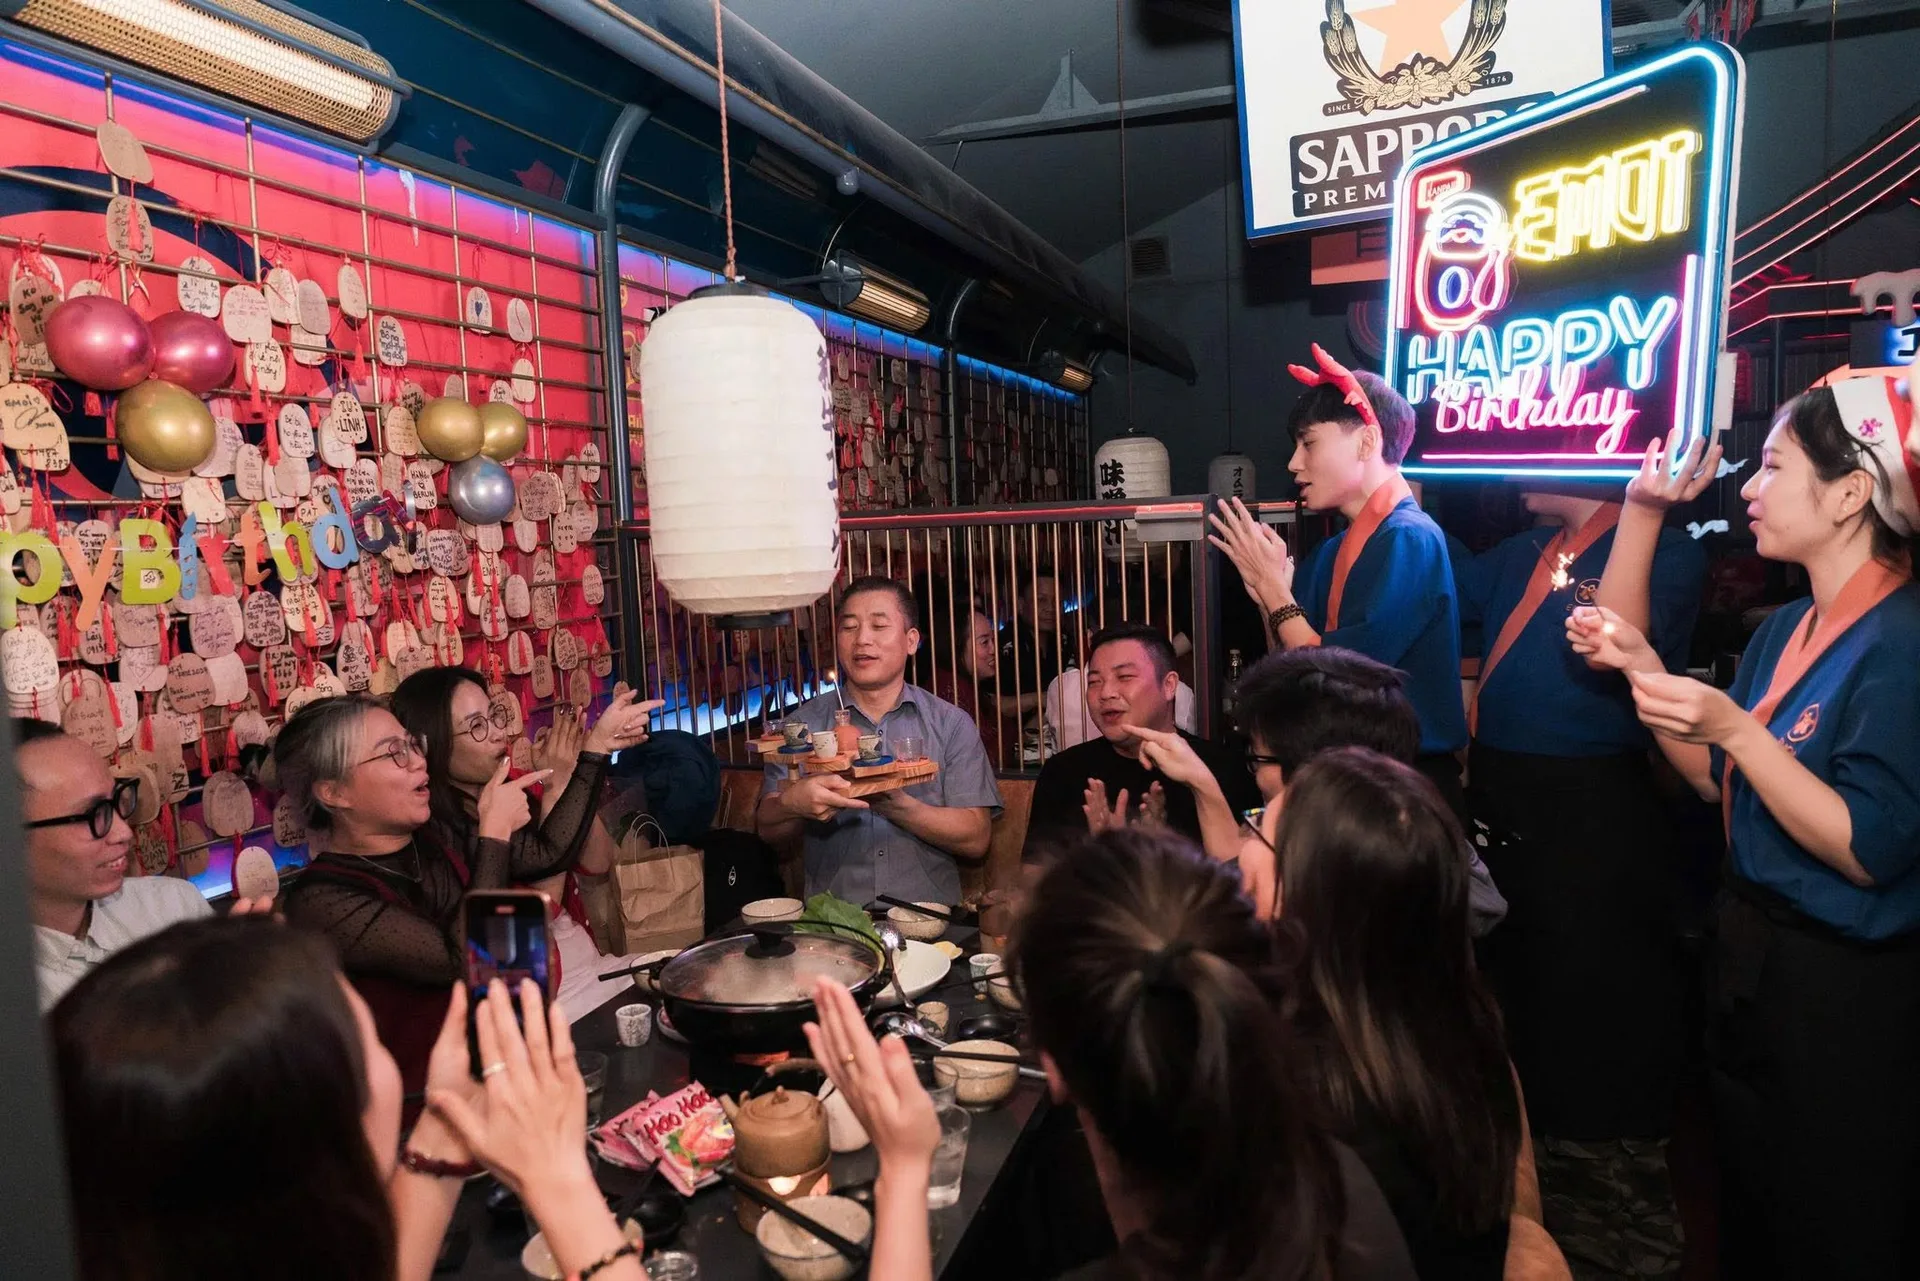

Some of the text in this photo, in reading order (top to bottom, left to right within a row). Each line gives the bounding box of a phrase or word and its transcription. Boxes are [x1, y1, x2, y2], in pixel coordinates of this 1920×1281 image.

[1485, 75, 1507, 85] 1876
[1327, 103, 1351, 114] SINCE
[1407, 296, 1682, 405] HAPPY
[1432, 360, 1640, 455] Birthday
[339, 418, 361, 433] LINH
